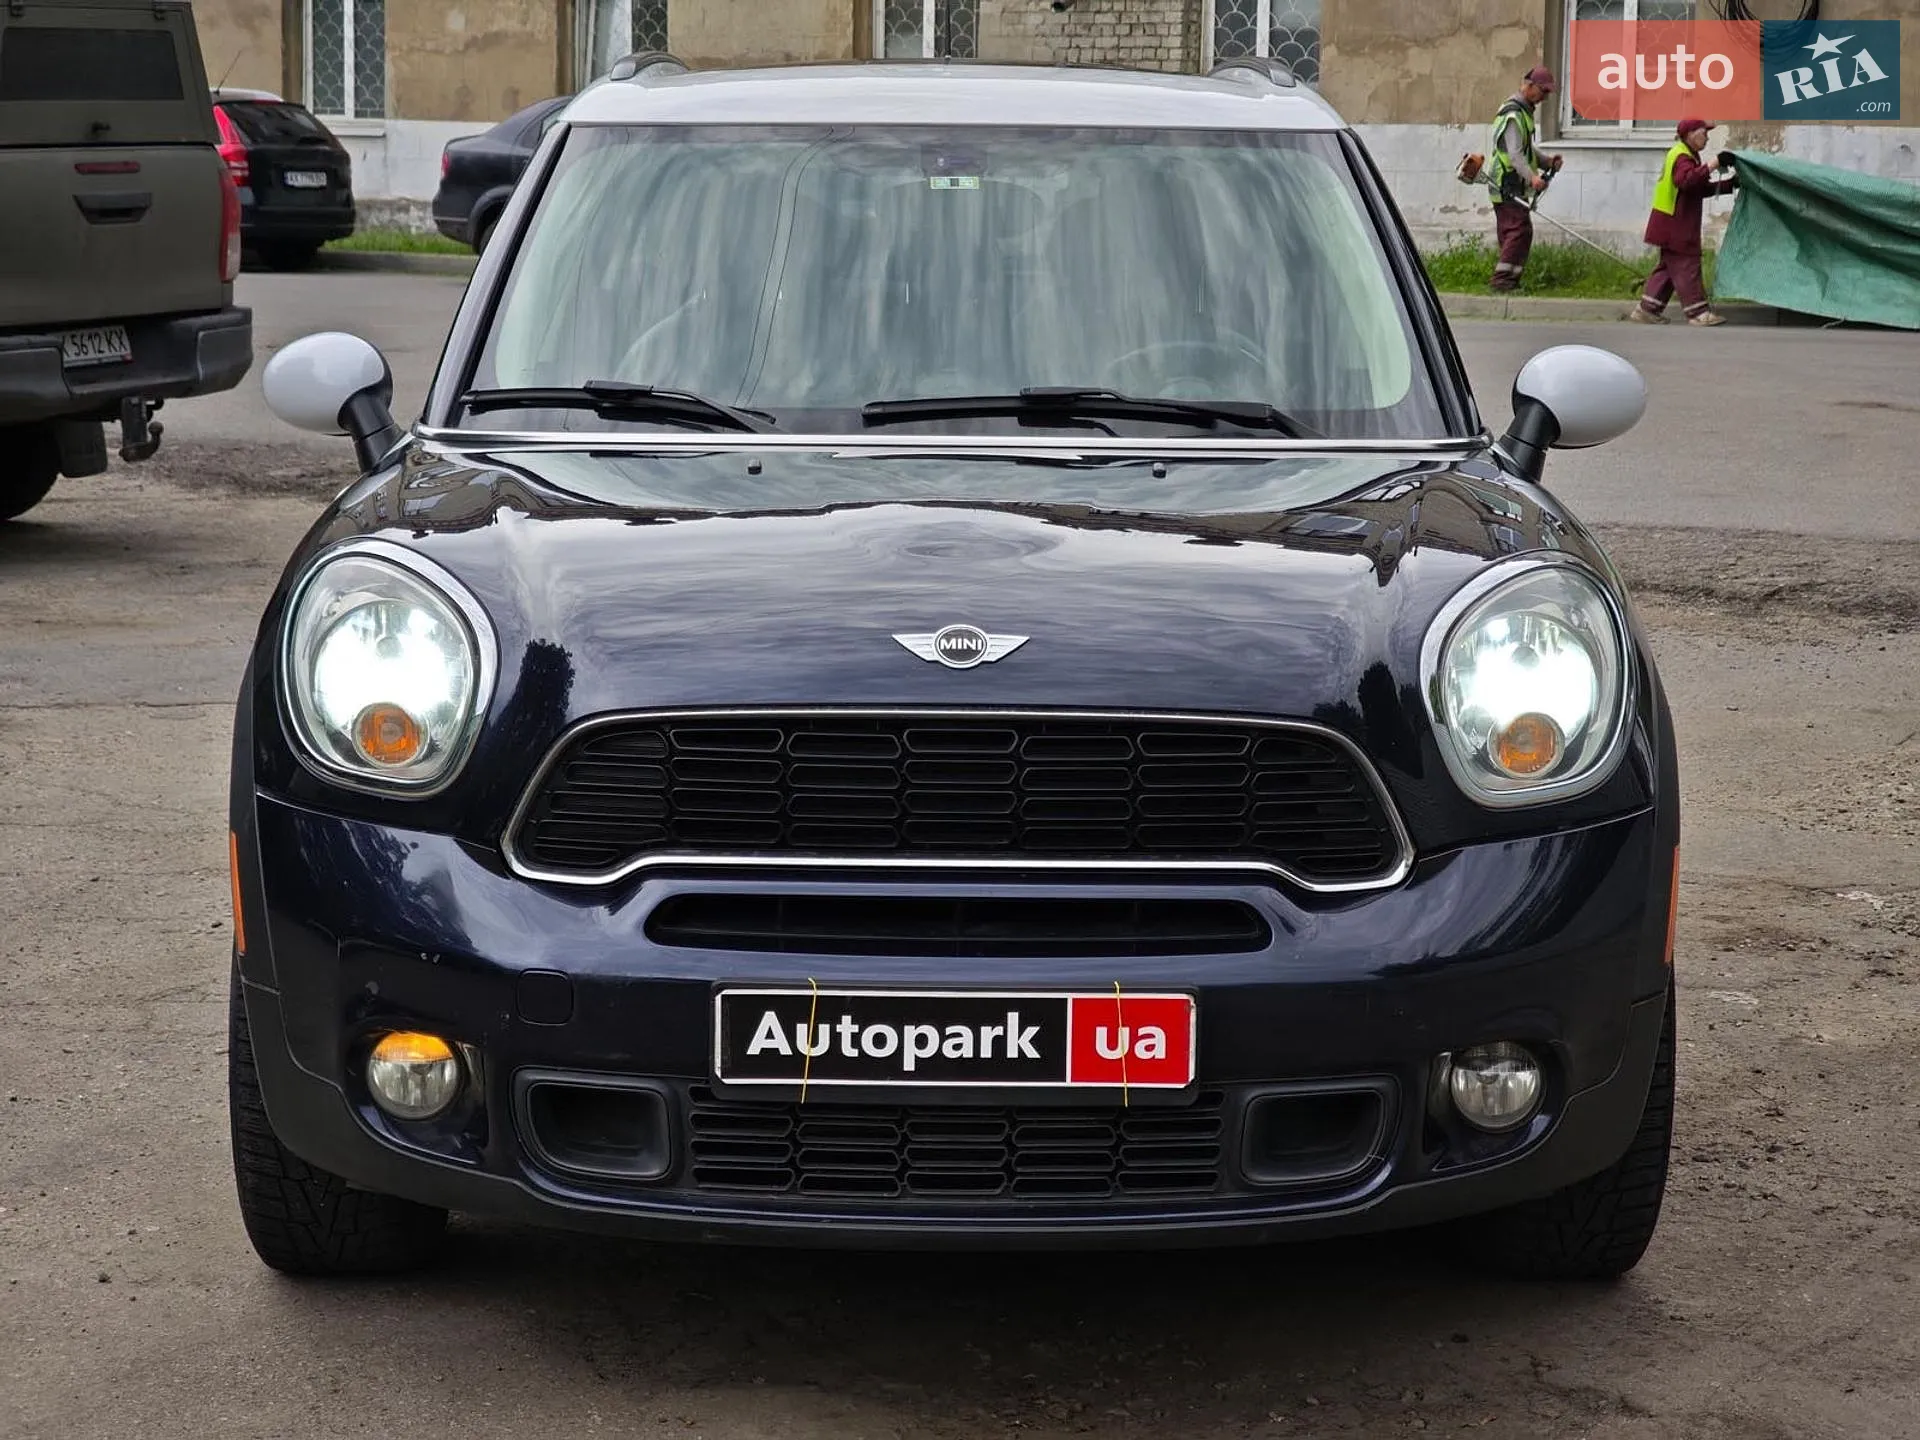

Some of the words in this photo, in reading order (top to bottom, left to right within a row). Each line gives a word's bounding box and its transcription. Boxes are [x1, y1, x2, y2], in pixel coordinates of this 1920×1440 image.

[940, 637, 983, 651] MINI
[745, 1010, 1041, 1072] Autopark
[1094, 1025, 1168, 1059] ua
